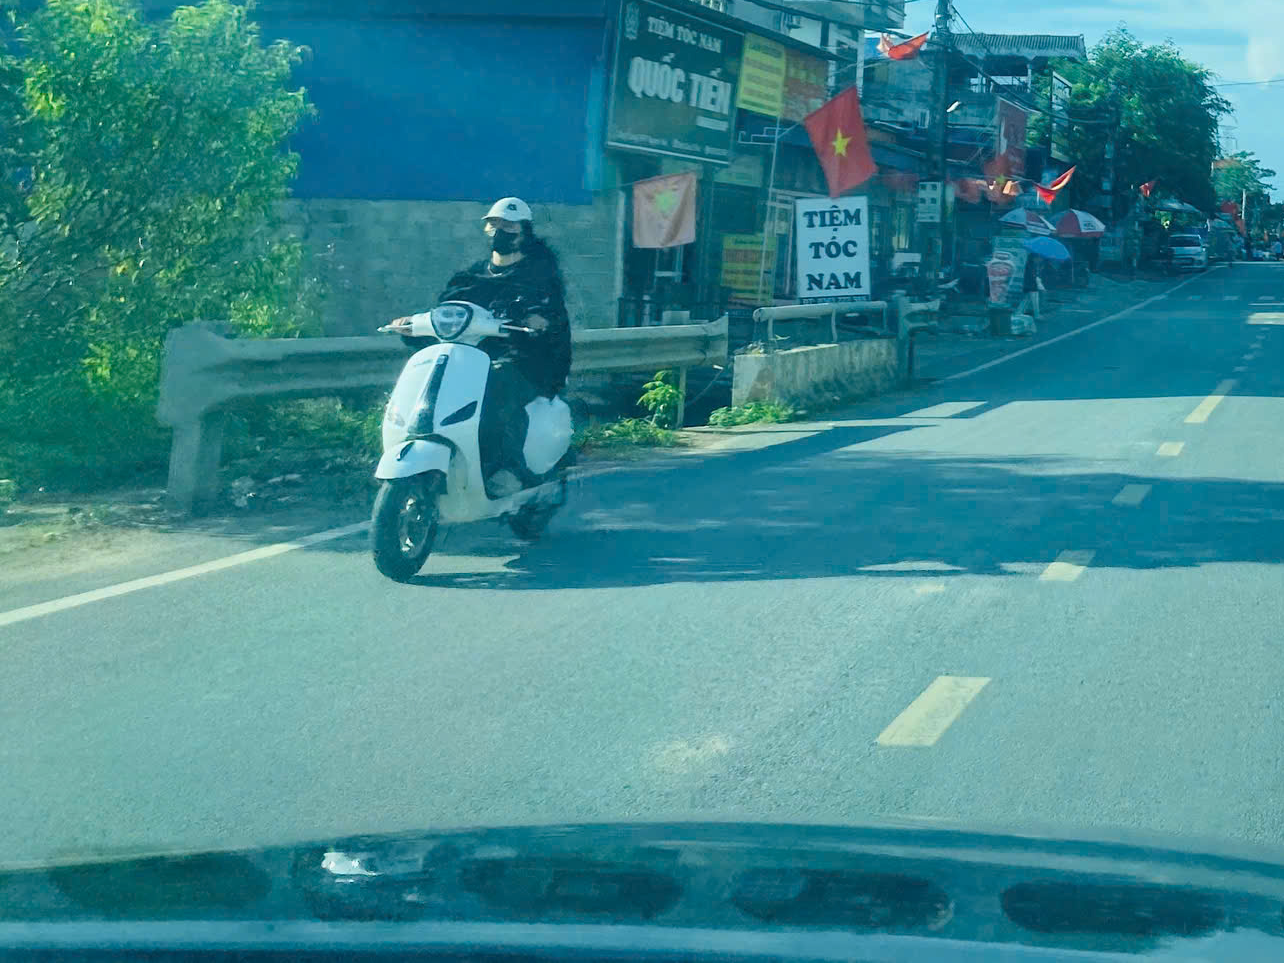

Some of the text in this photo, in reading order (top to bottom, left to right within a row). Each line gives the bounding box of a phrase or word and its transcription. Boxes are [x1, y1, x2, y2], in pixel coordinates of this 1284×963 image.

[648, 15, 722, 53] TIỆM TÓC NAM
[628, 53, 685, 103] QUỐC
[803, 205, 862, 232] TIỆM
[809, 236, 857, 259] TÓC
[806, 271, 862, 290] NAM
